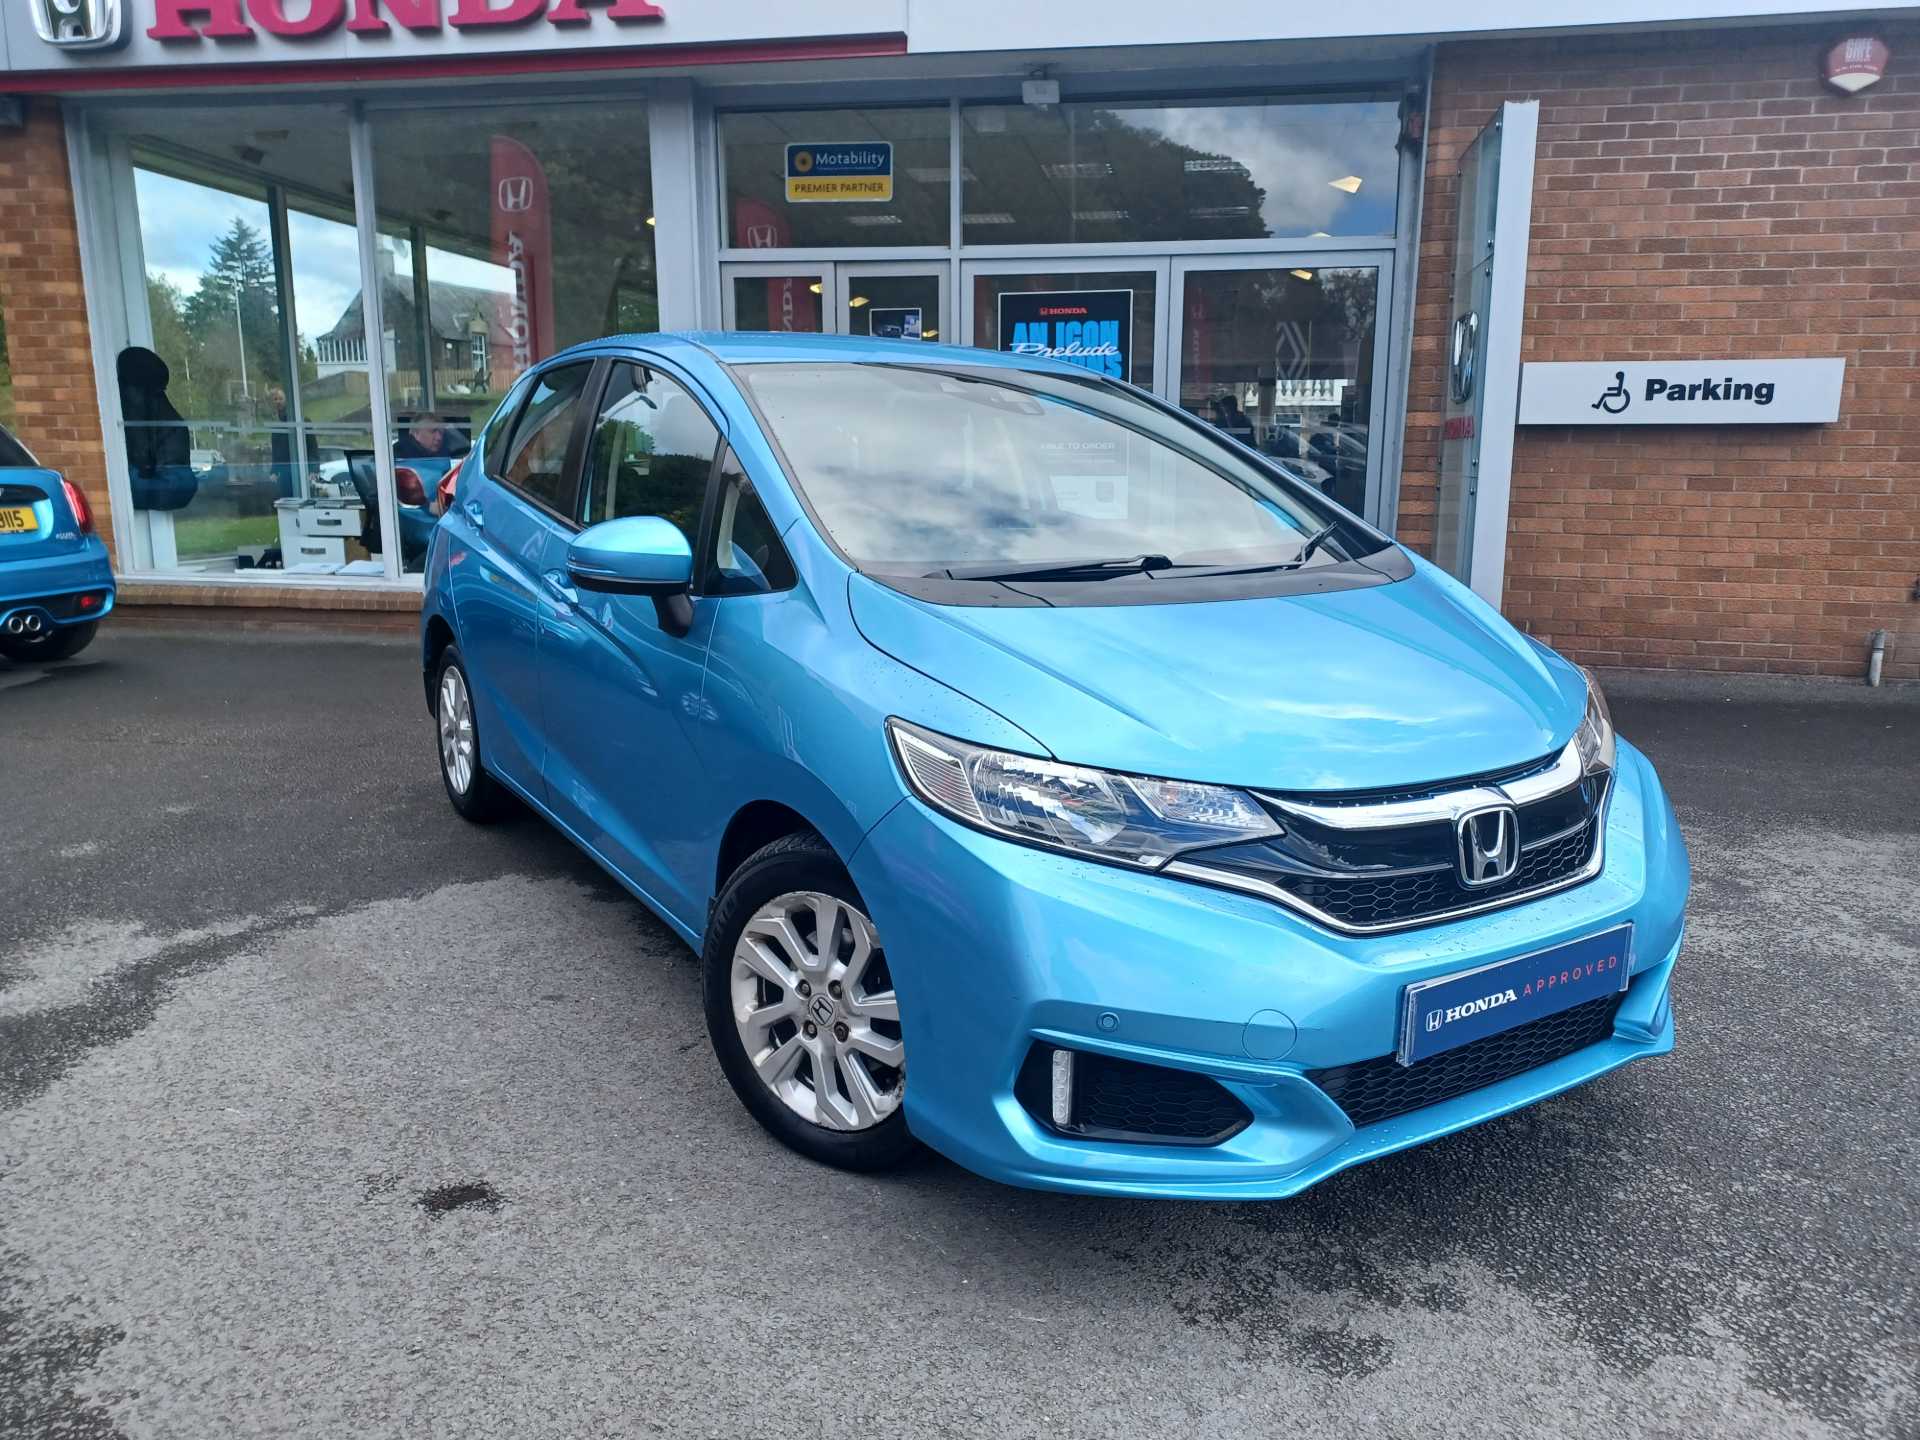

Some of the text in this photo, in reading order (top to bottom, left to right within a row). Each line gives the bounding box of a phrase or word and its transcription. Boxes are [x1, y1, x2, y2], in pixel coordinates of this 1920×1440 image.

[147, 0, 664, 39] HON
[815, 151, 885, 167] Motability
[794, 183, 884, 193] PREMIER PARTNER
[1049, 306, 1088, 315] HONDA
[1055, 320, 1119, 352] ICON
[1009, 341, 1119, 357] Prelude
[1645, 377, 1775, 405] Parking
[1445, 956, 1617, 1024] HONDA APPROVED
